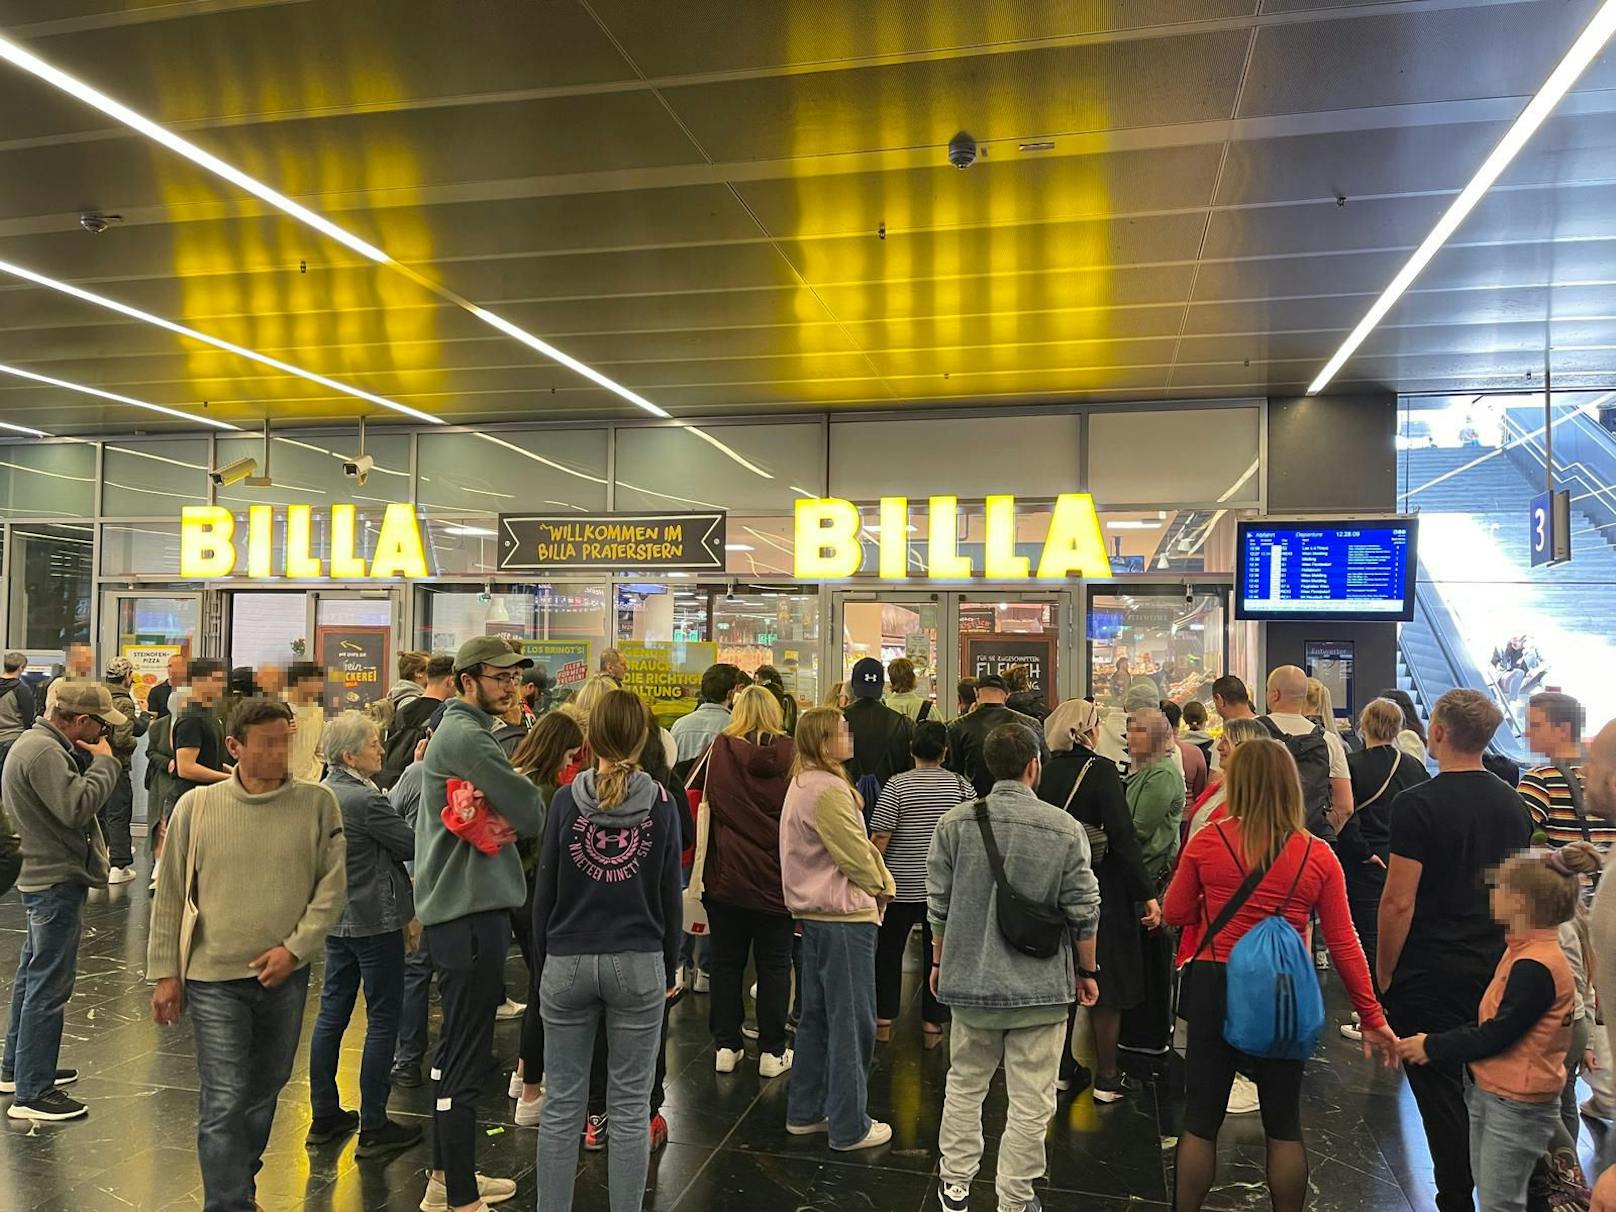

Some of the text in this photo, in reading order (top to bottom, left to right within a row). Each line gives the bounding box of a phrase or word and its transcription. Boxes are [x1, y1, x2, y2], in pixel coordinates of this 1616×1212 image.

[180, 503, 428, 578] BILLA
[549, 524, 682, 542] WILLKOMMEN IM
[793, 493, 1113, 578] BILLA
[1535, 508, 1545, 552] 3
[538, 543, 683, 560] BILLA PRATERSTERN
[624, 648, 672, 657] GENUS
[623, 672, 643, 684] DIE
[605, 857, 640, 882] NINETY
[636, 840, 652, 858] SIX
